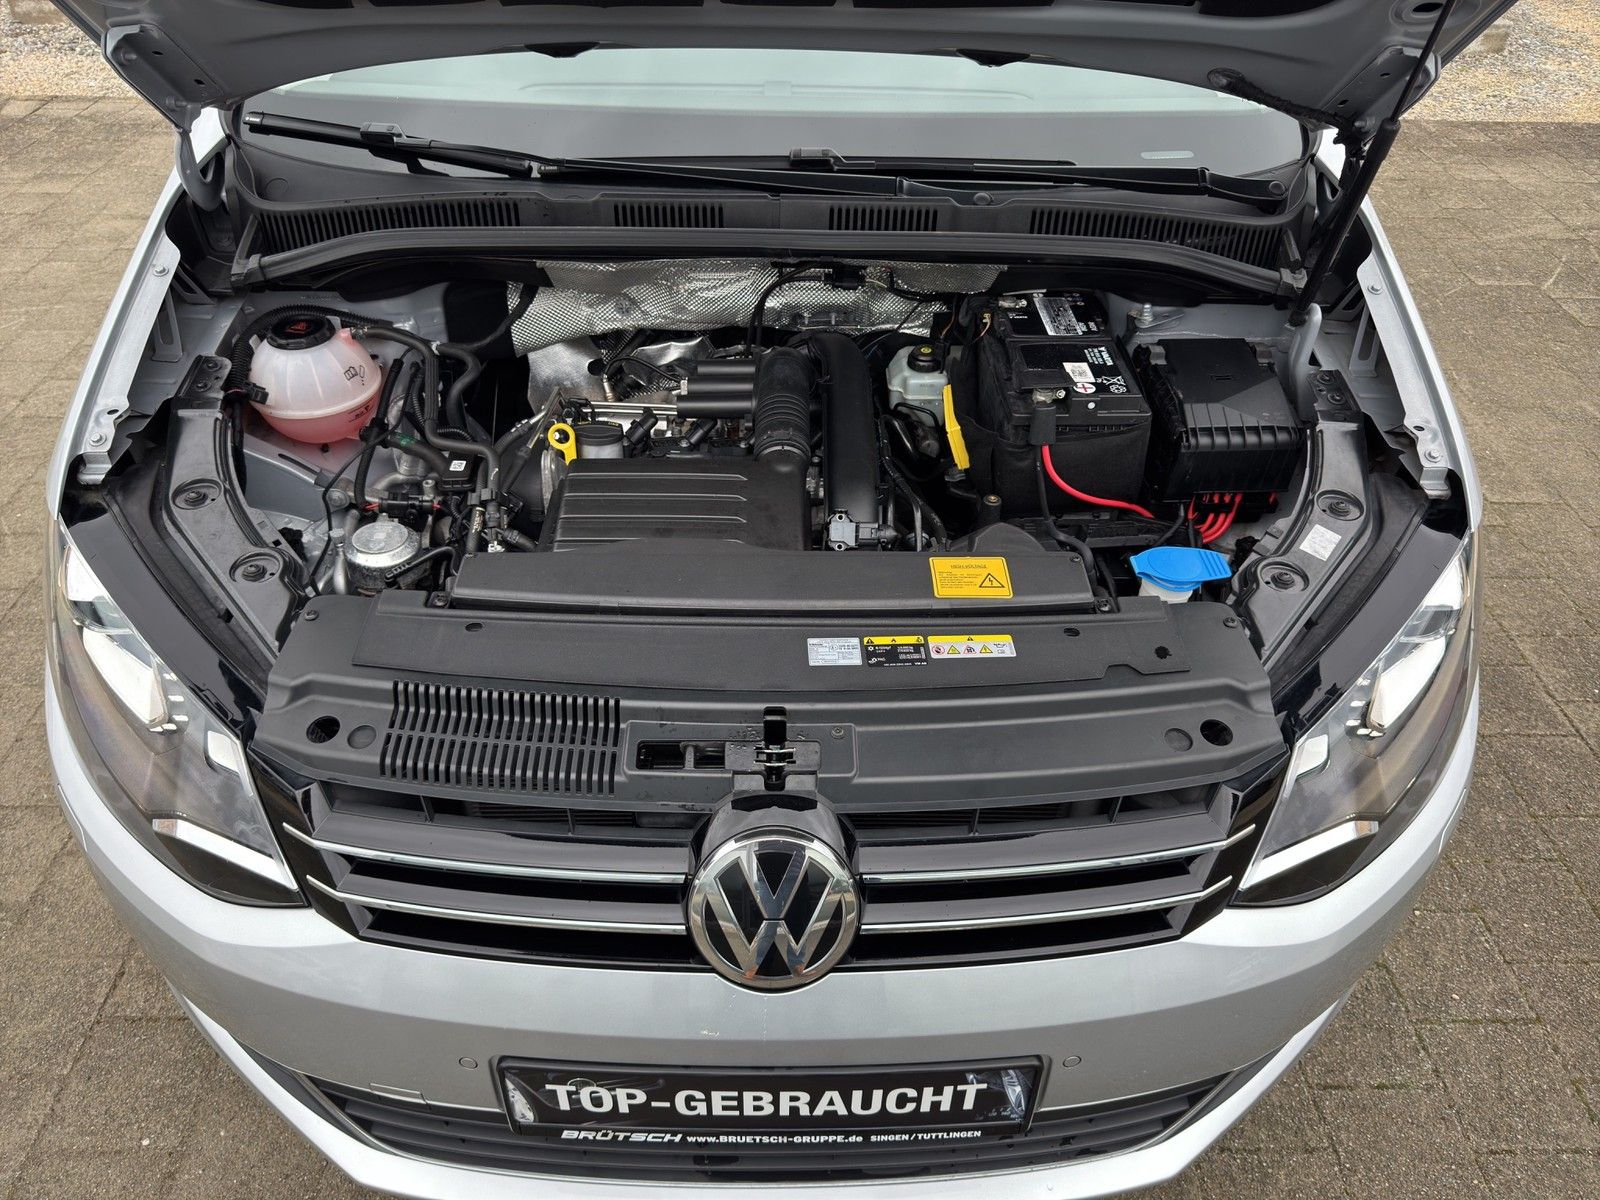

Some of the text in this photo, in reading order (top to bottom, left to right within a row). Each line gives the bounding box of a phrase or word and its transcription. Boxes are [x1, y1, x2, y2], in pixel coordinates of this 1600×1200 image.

[545, 1083, 988, 1117] TOP-GEBRAUCHT
[560, 1129, 683, 1143] BRÜTSCH
[686, 1134, 863, 1144] www.BRUETSCH-GRUPPE.de
